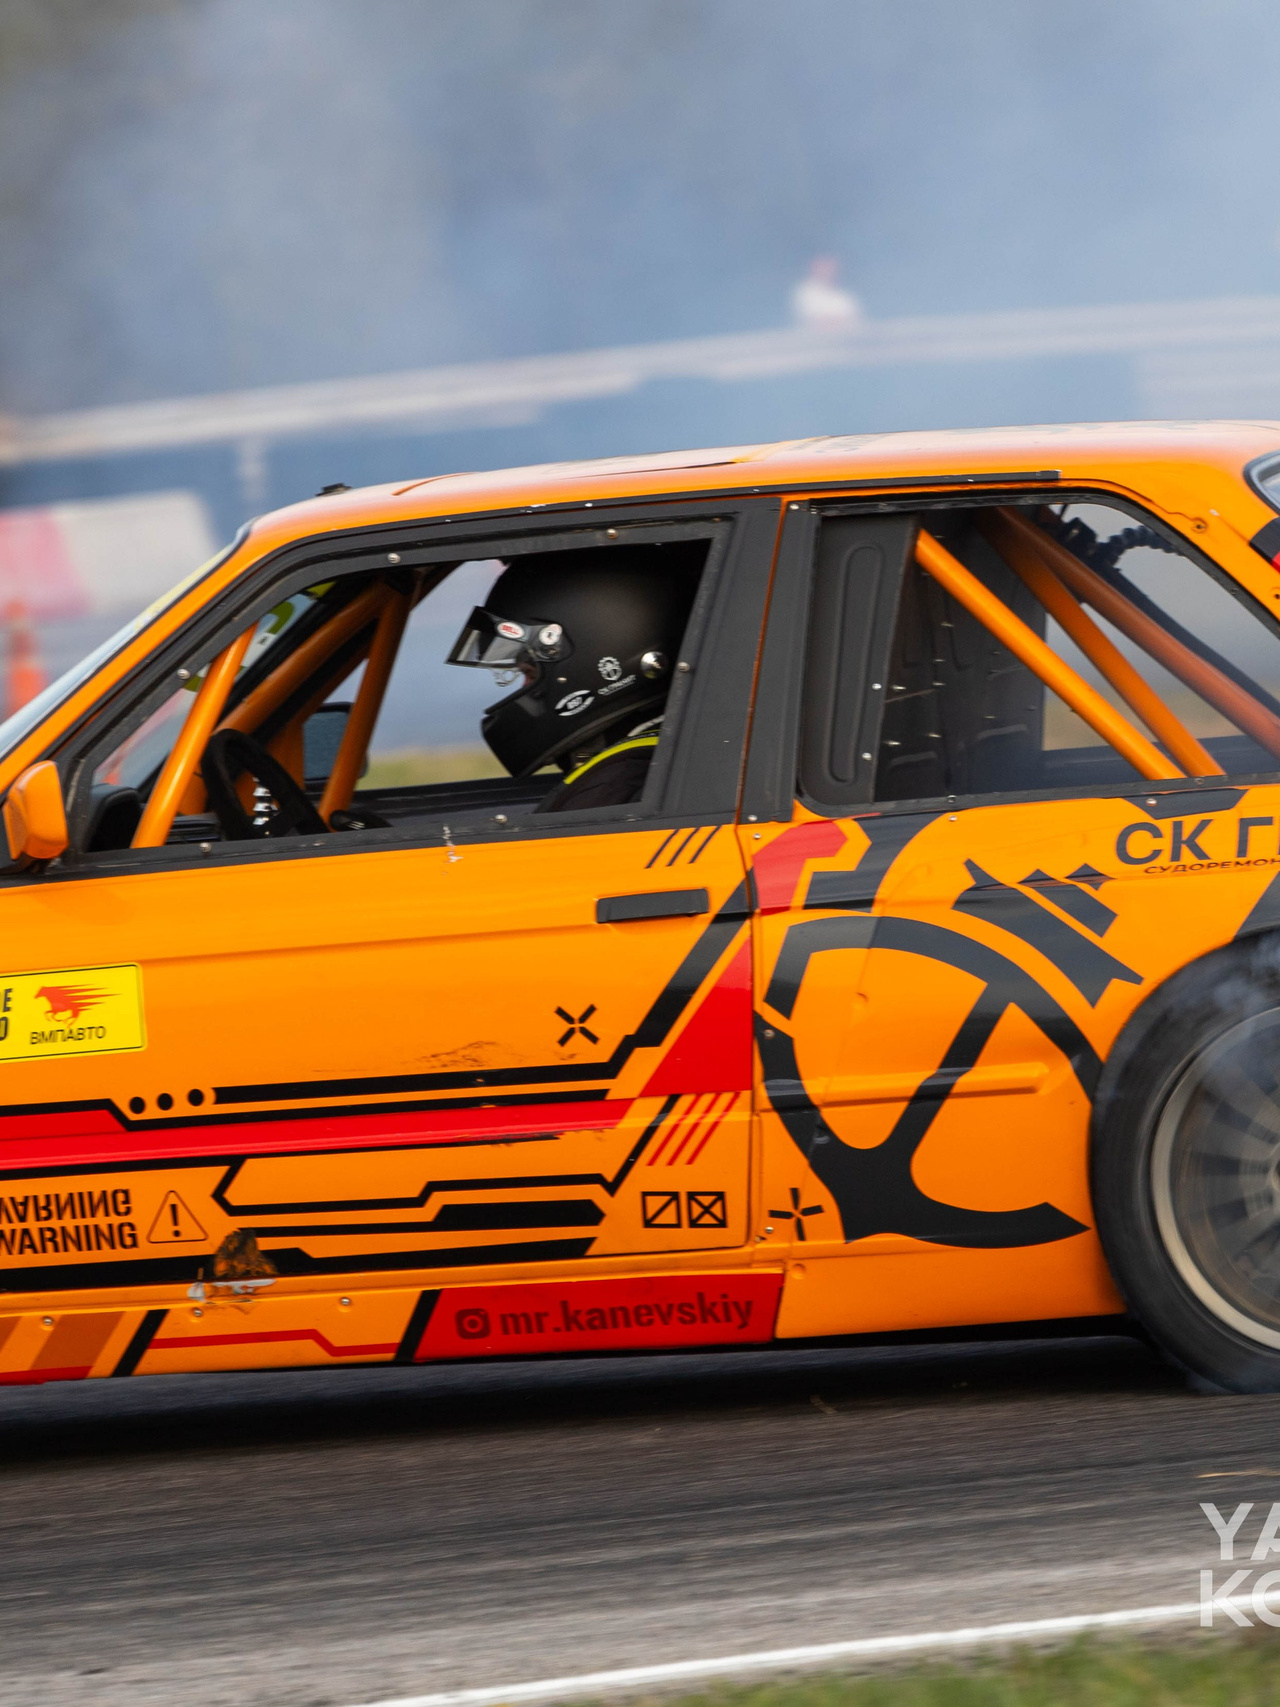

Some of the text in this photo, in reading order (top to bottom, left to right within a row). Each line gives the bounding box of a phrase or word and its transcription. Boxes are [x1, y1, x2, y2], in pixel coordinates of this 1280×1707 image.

[1115, 818, 1213, 865] СК
[29, 1025, 107, 1045] ВМПАВТО
[499, 1291, 753, 1335] mr.kanevskiy
